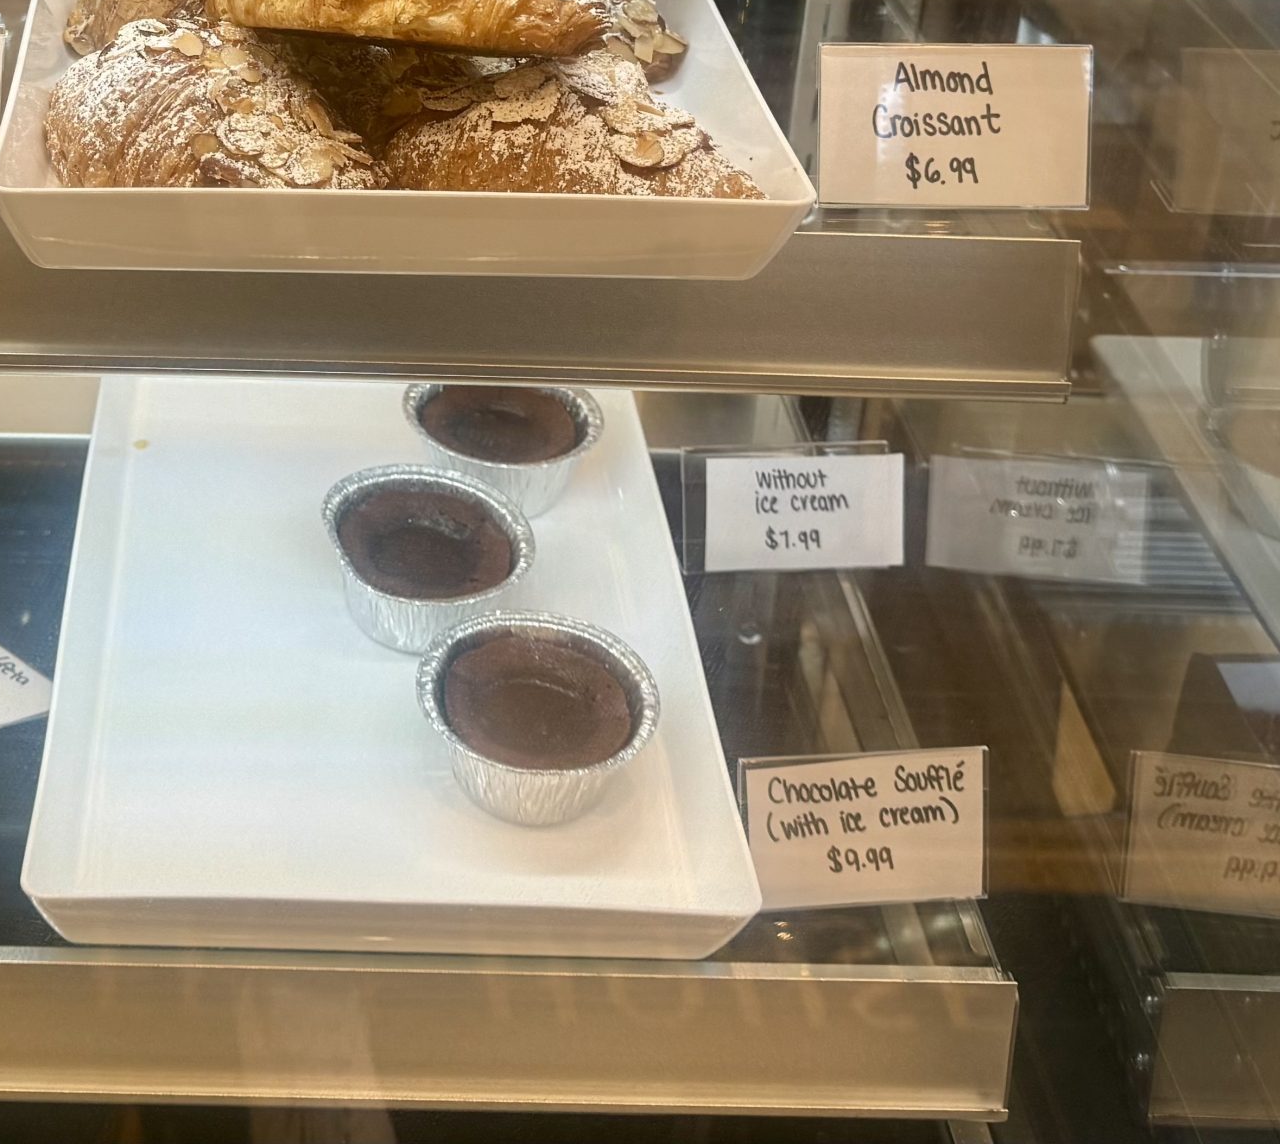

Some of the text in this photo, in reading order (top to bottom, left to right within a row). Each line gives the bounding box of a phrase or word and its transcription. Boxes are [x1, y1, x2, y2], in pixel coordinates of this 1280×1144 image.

[894, 61, 993, 95] Almond
[872, 103, 1001, 138] Croissant
[905, 153, 979, 189] $6.99
[755, 491, 849, 514] ice cream
[768, 760, 965, 804] Chocolate Soufflé
[766, 797, 959, 842] (with ice cream)
[826, 845, 894, 873] $9.99
